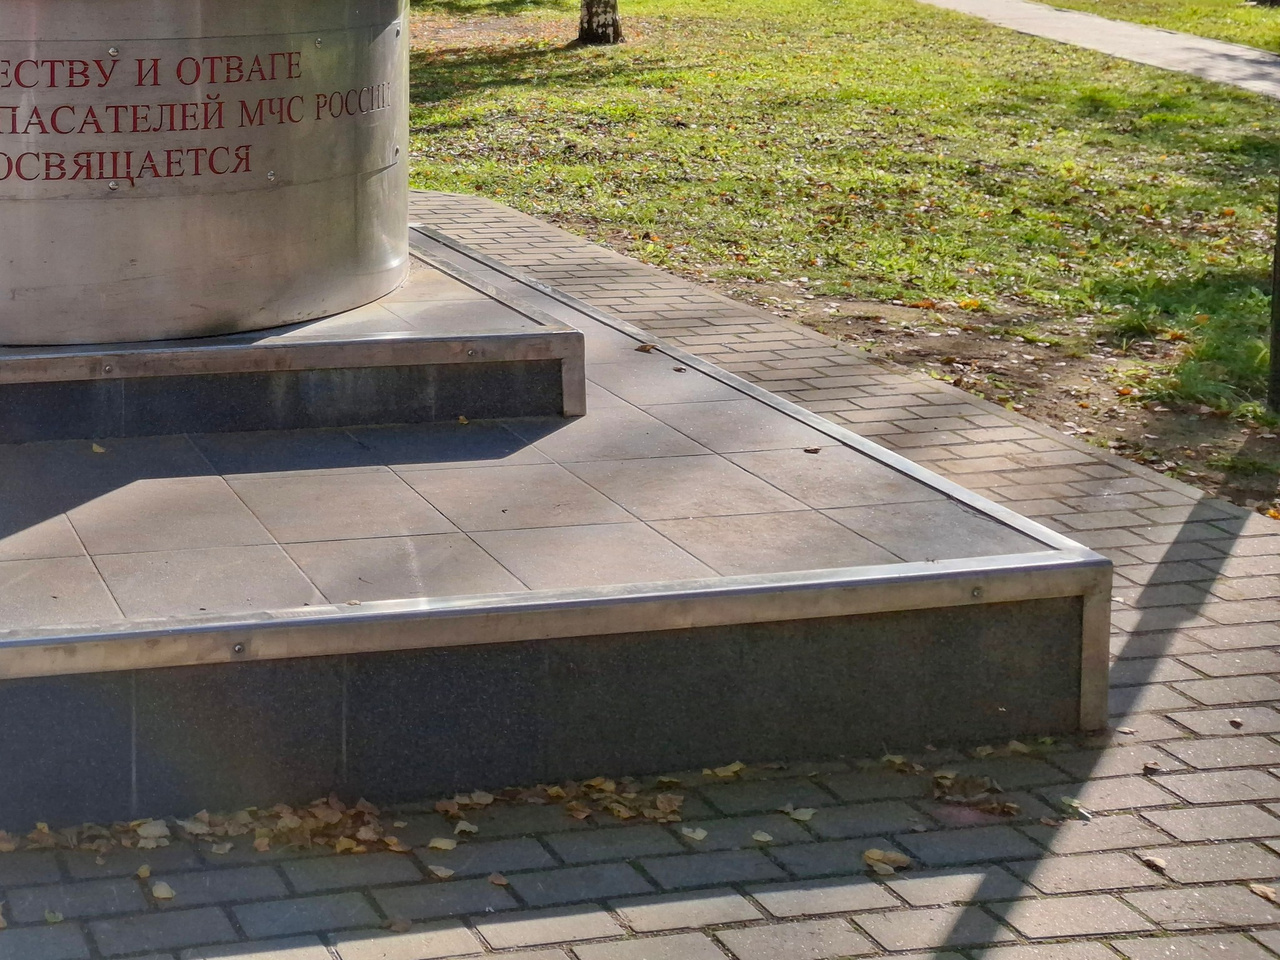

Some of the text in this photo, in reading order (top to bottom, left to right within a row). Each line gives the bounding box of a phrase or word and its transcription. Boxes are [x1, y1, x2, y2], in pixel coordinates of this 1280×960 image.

[134, 58, 161, 87] И
[176, 51, 302, 86] ОТВАГЕ
[238, 95, 304, 128] МЧС
[314, 82, 391, 121] РОССИИ
